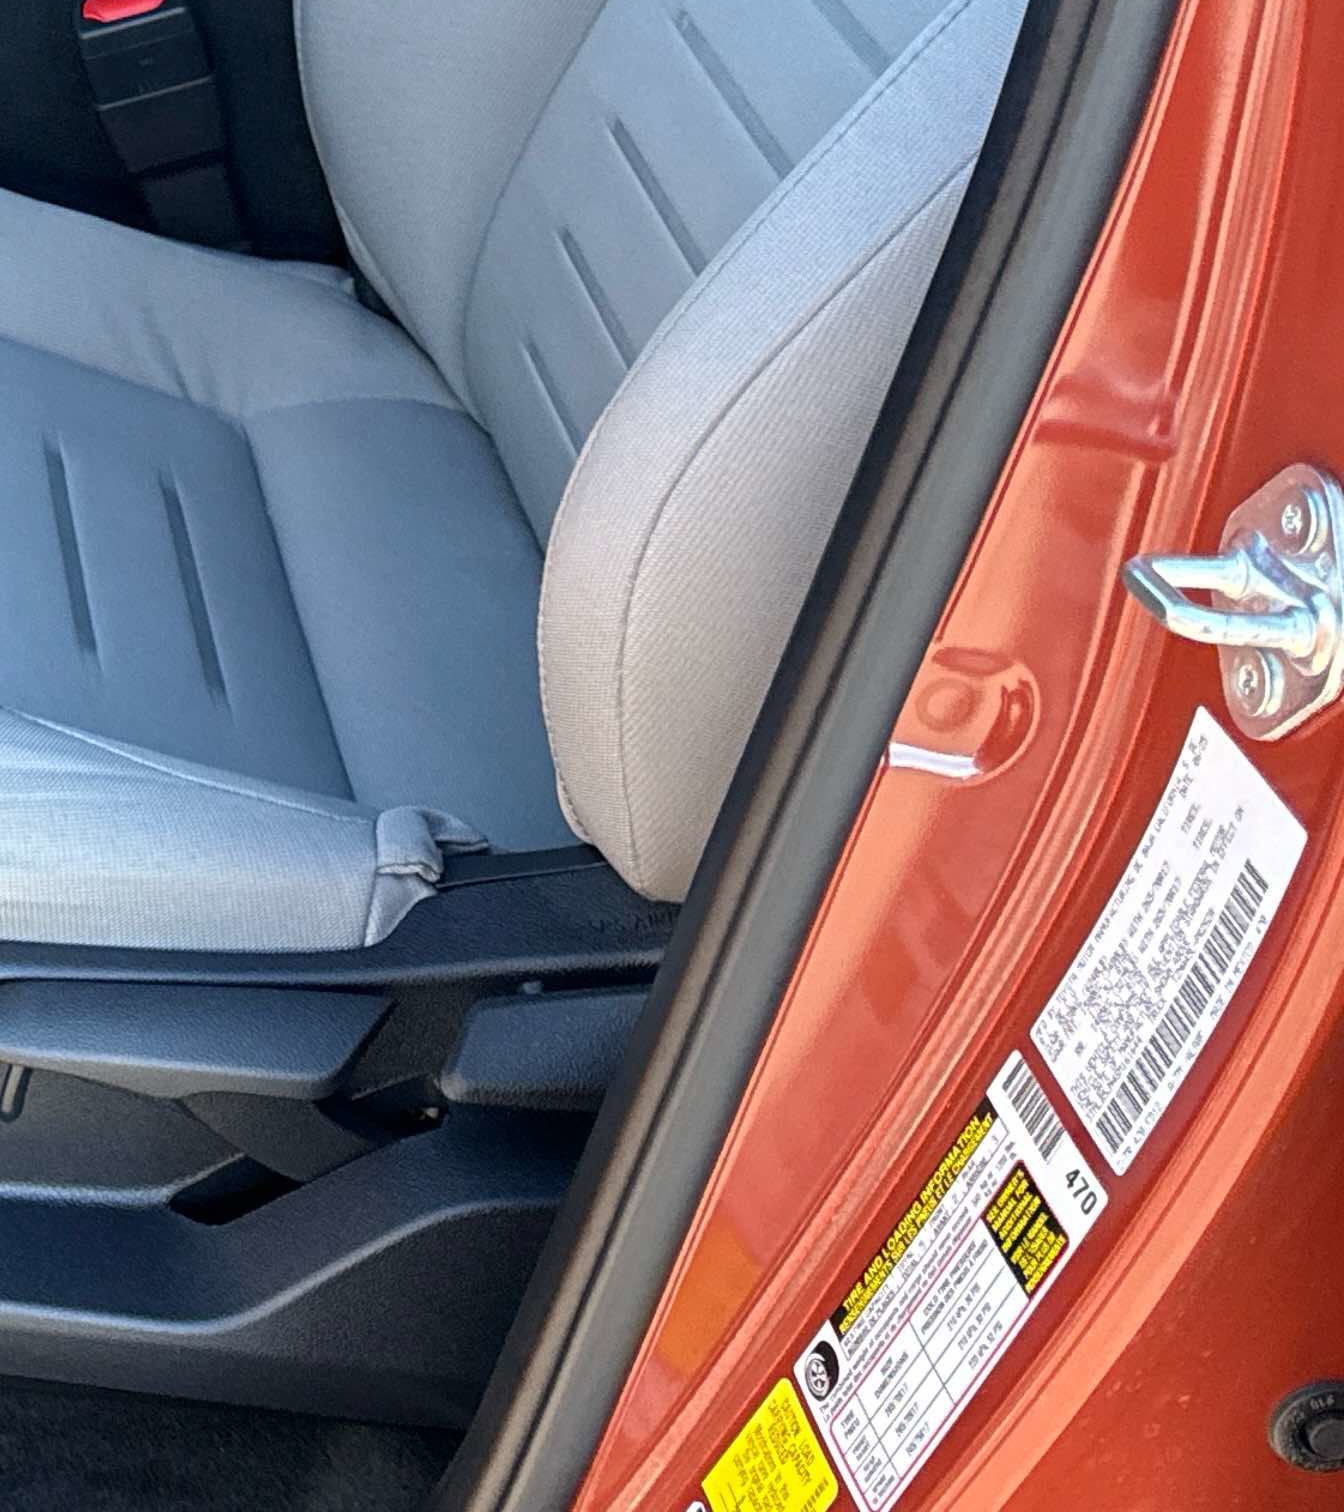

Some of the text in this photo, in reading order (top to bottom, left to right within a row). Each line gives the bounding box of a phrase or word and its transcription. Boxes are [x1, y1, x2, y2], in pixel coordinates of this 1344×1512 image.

[842, 1115, 980, 1313] TIRE AND LOADING INFORMATION
[1064, 1167, 1097, 1216] 470
